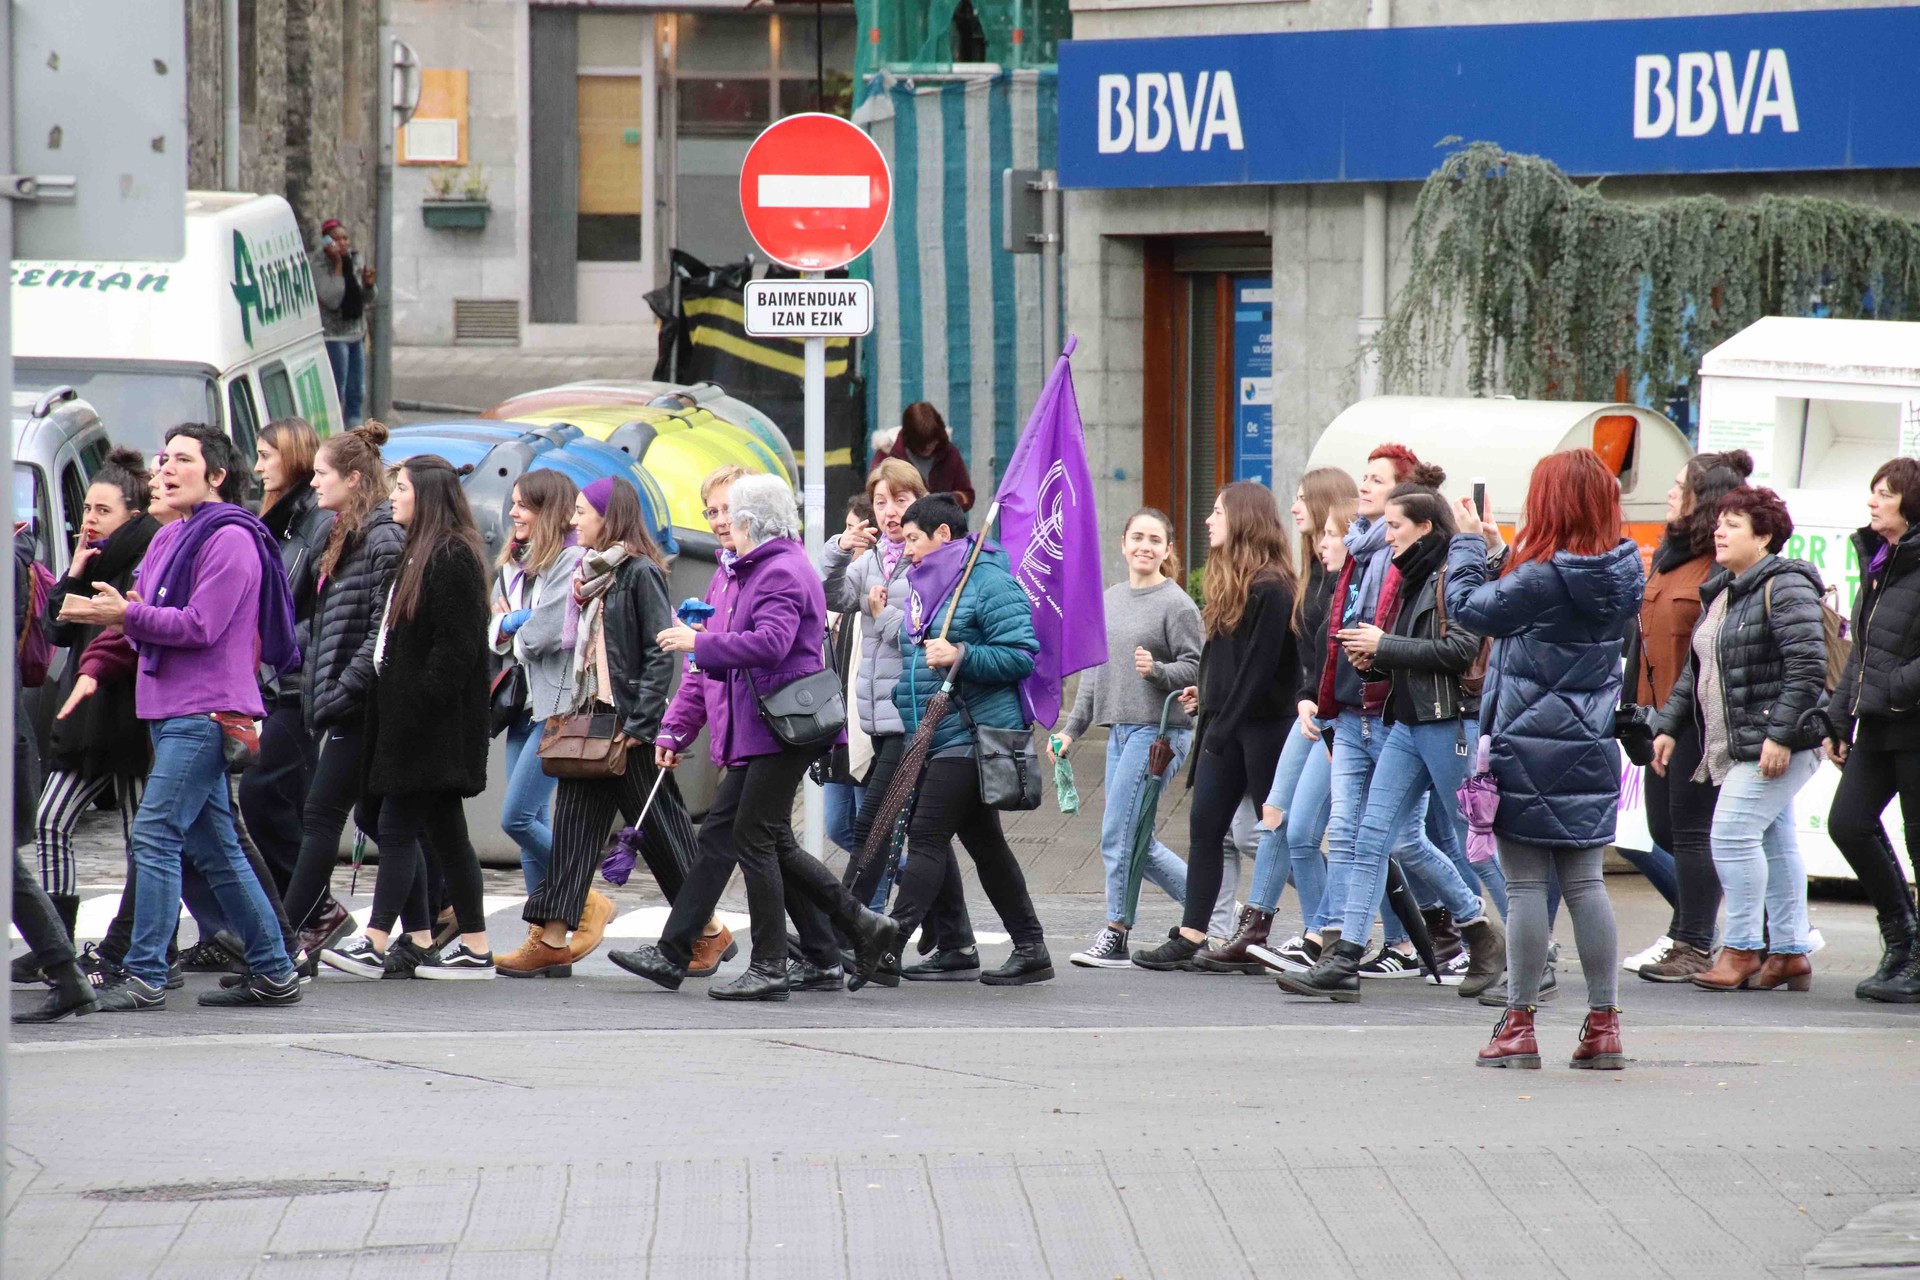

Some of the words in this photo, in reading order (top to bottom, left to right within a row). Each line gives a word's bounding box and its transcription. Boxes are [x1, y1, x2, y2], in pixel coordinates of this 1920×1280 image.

[1097, 70, 1244, 154] BBVA
[1633, 48, 1799, 139] BBVA
[757, 292, 857, 306] BAIMENDUAK
[772, 312, 805, 326] IZAN
[811, 312, 843, 326] EZIK
